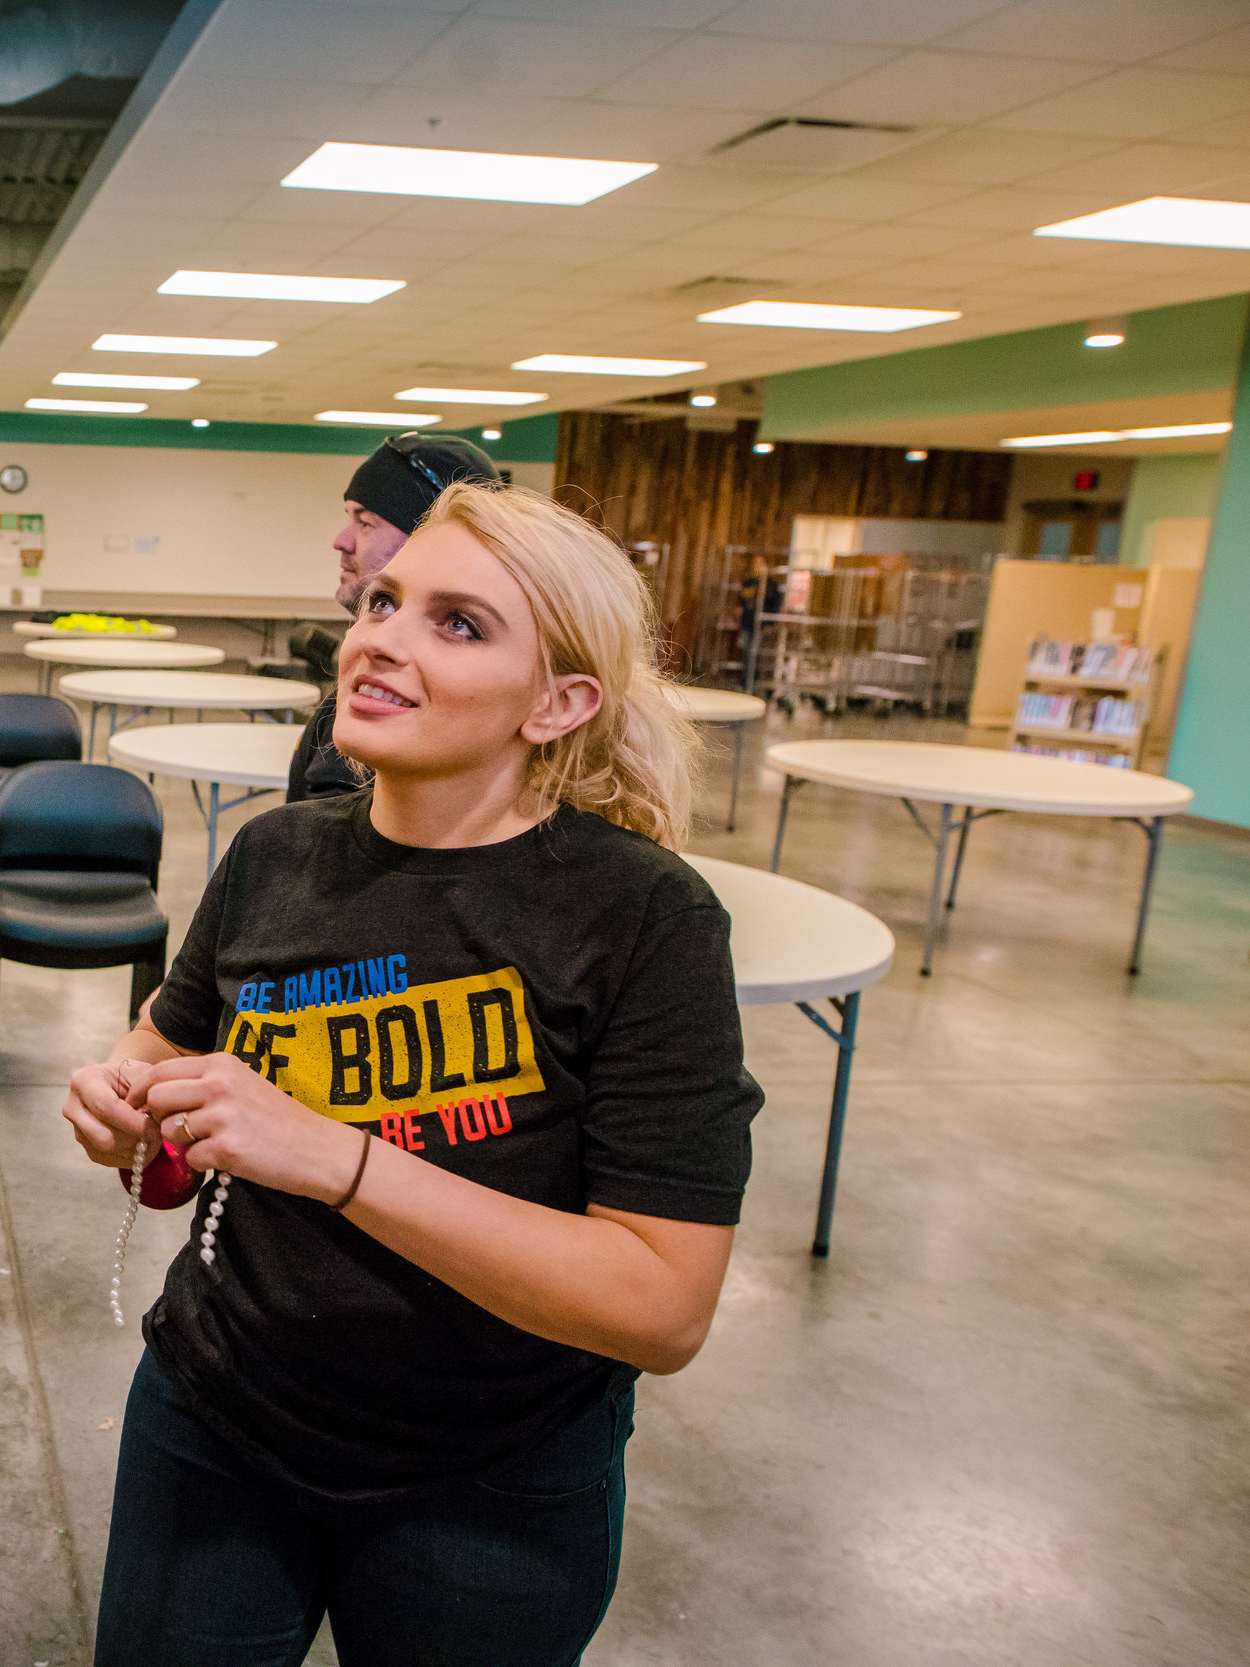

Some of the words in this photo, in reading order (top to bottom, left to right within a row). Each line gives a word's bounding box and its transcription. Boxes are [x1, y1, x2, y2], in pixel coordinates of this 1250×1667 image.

[235, 982, 275, 1014] BE
[284, 954, 408, 1015] AMAZING
[327, 987, 520, 1105] BOLD
[381, 1109, 425, 1151] BE
[437, 1092, 513, 1146] YOU
